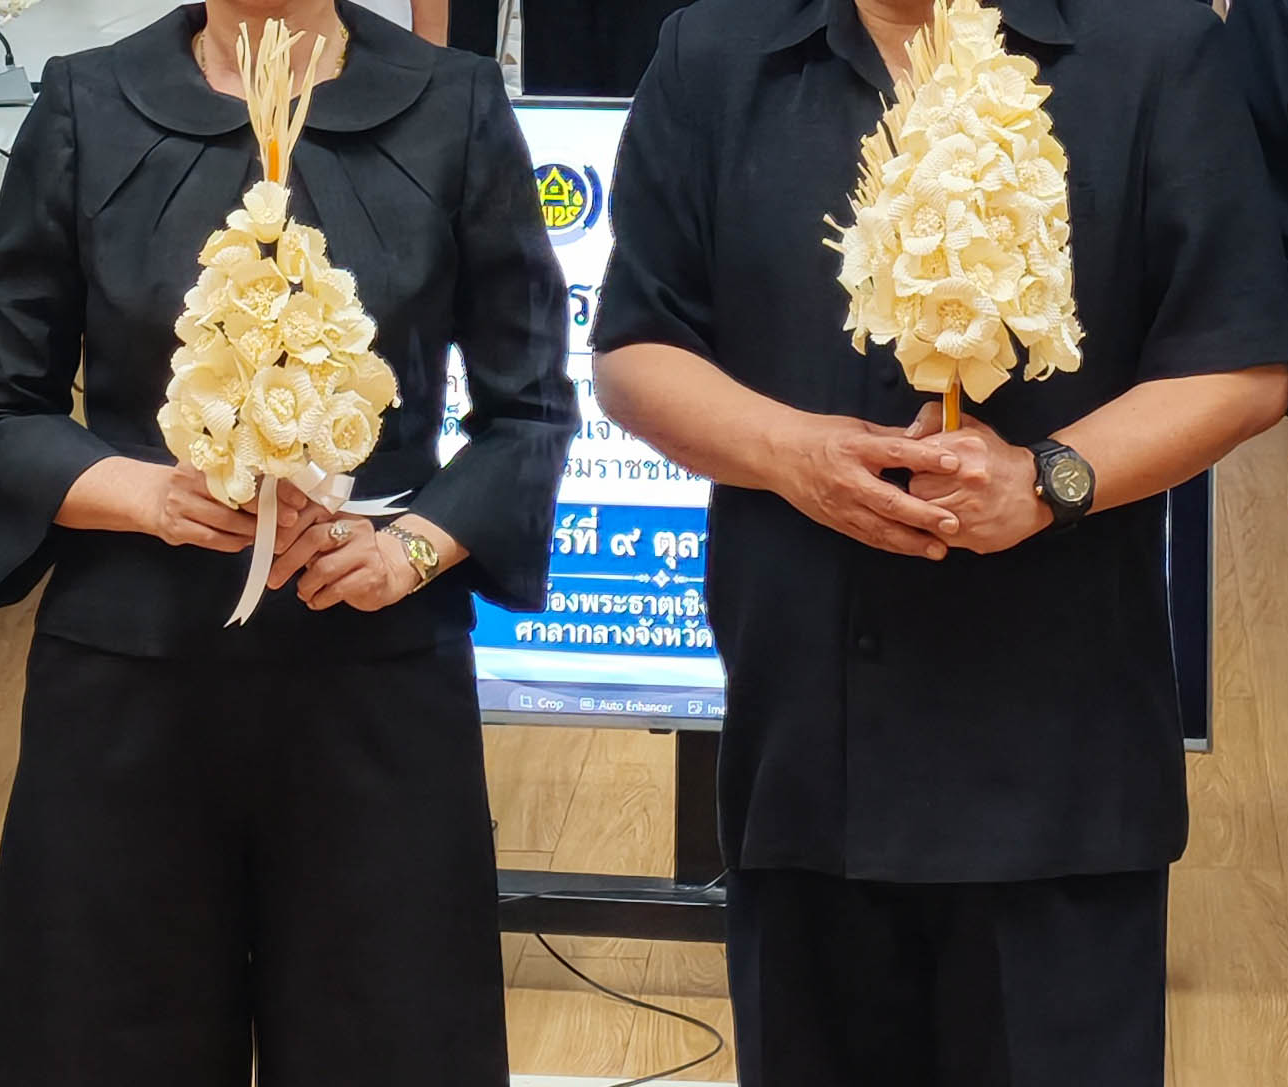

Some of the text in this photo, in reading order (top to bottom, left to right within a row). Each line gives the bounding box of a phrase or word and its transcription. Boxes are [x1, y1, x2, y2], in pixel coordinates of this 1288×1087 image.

[653, 530, 707, 570] ตุล
[537, 698, 564, 711] Crop
[598, 699, 673, 713] Auto Enhancer
